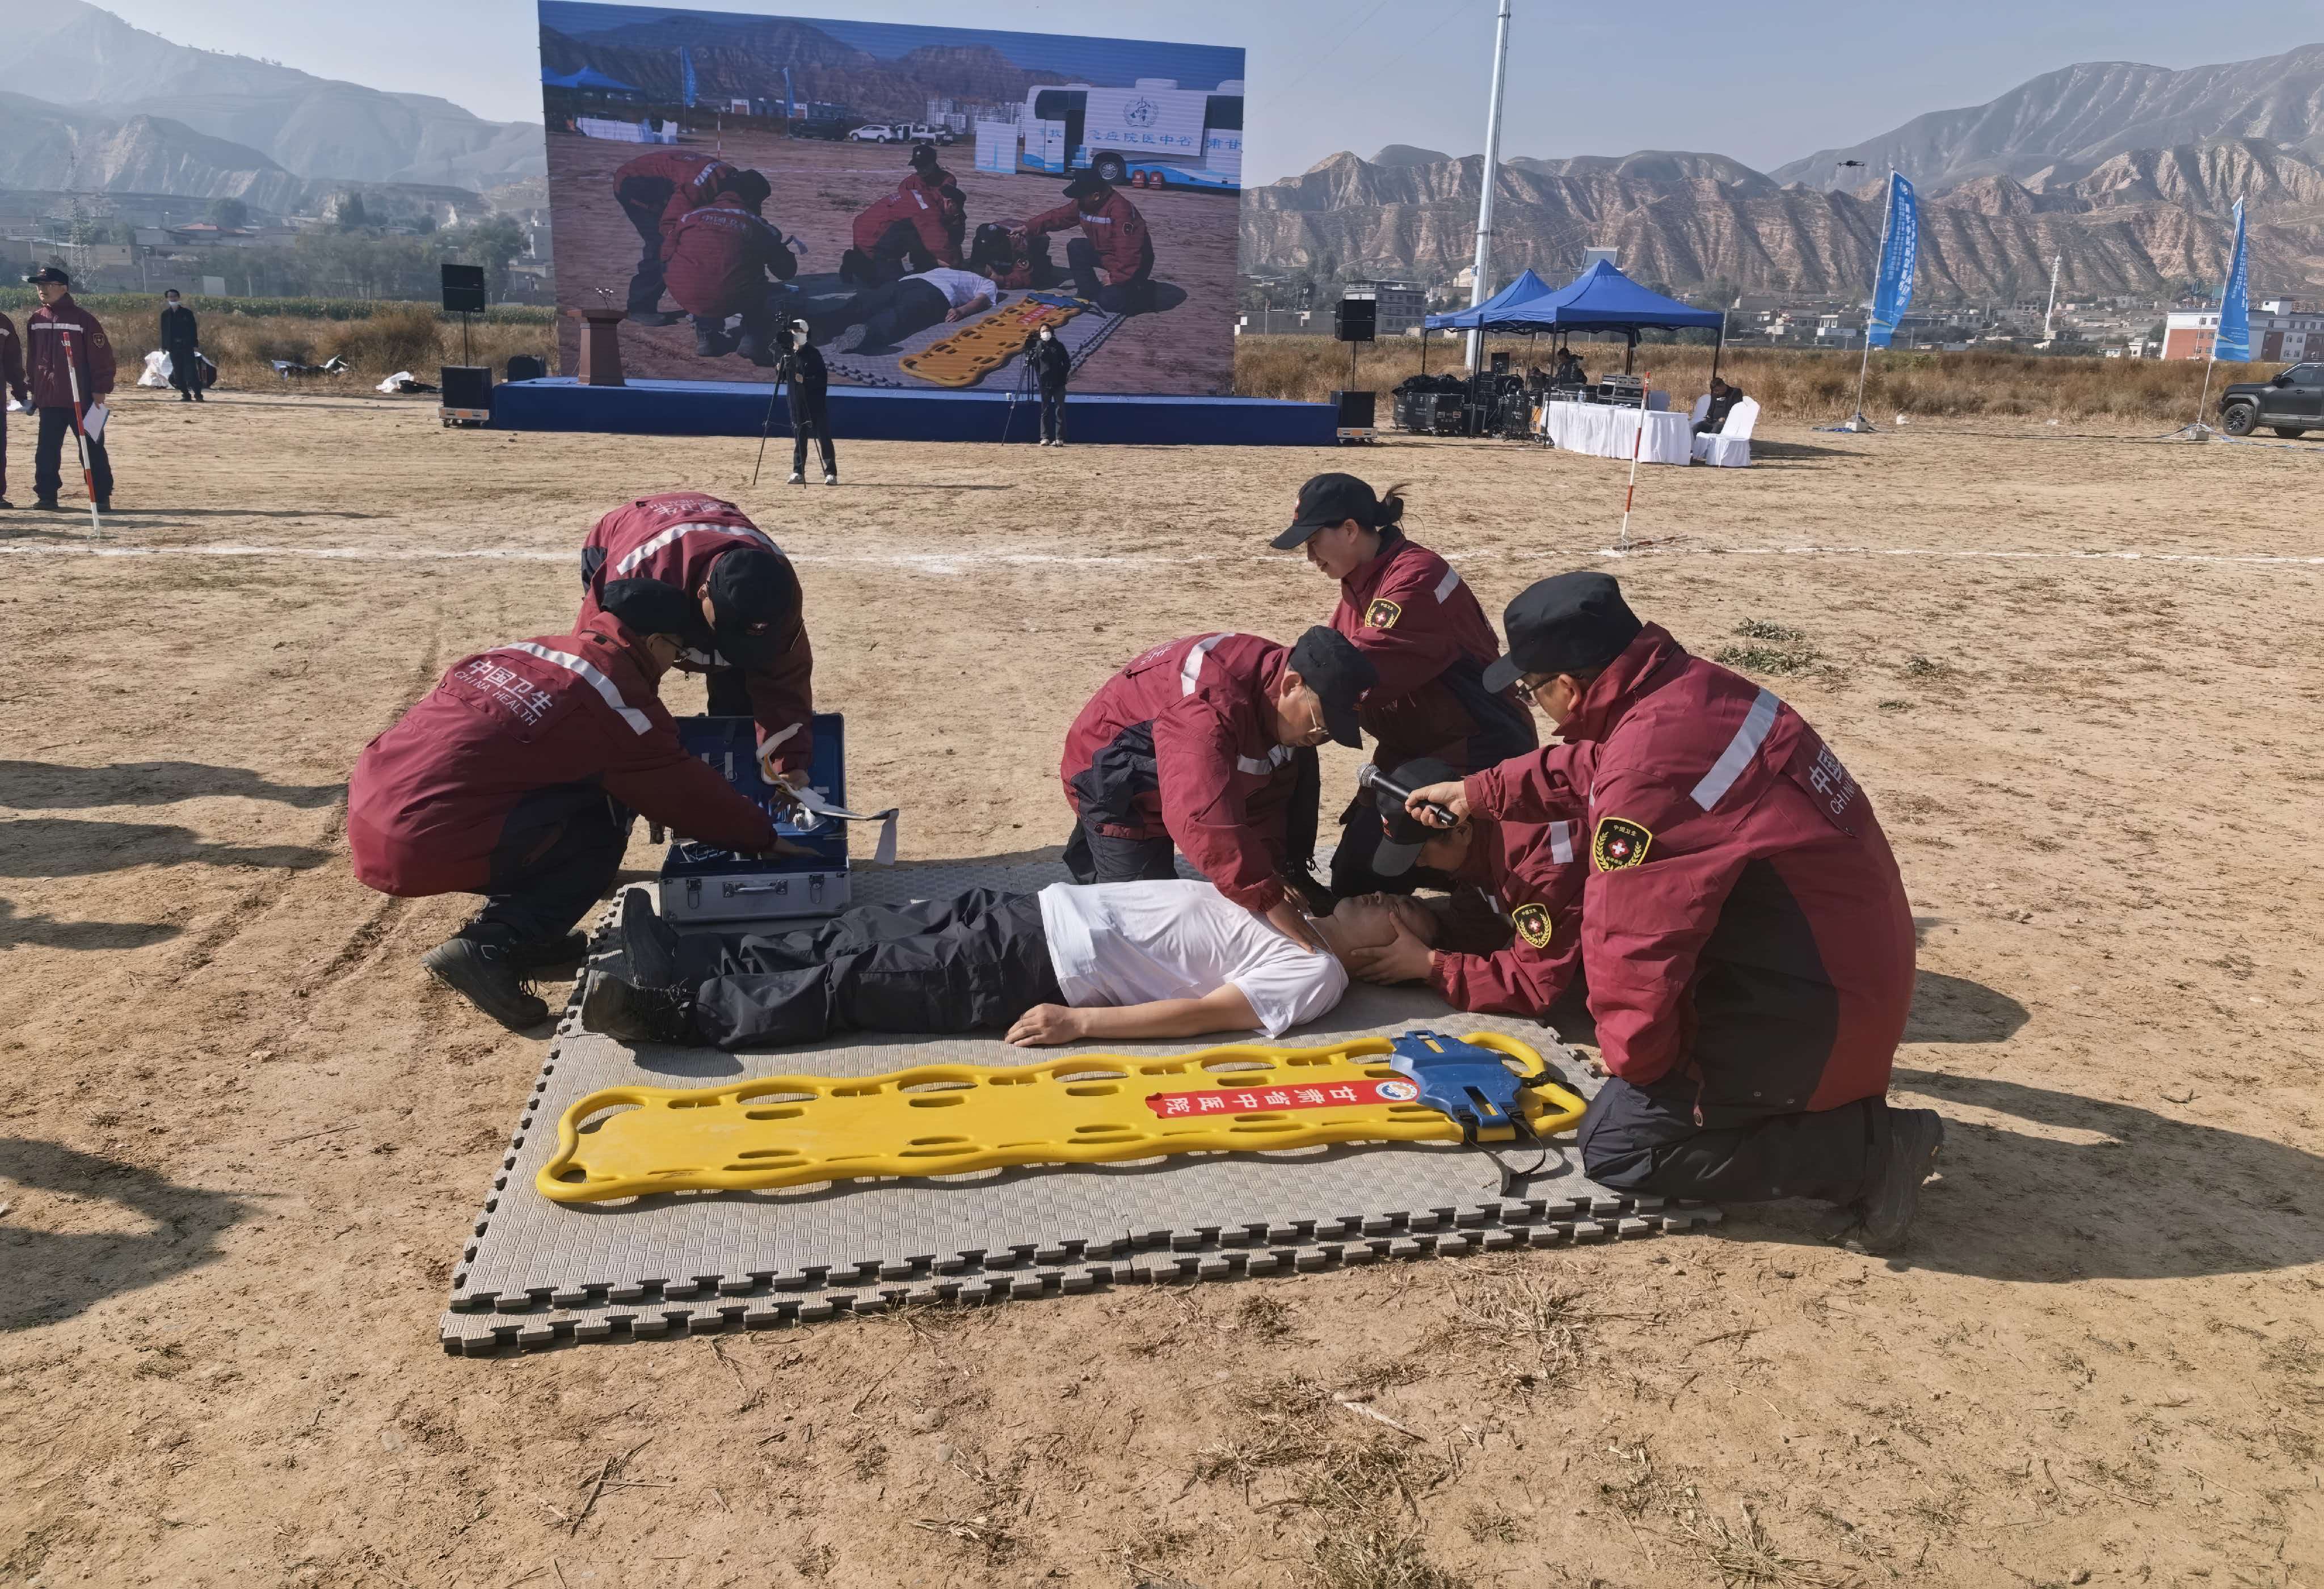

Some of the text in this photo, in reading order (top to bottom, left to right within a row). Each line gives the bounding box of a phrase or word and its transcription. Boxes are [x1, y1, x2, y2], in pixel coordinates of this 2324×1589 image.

[454, 671, 538, 726] CHINA HEALTH
[468, 660, 553, 718] 中国卫生
[1164, 1085, 1358, 1114] 甘肃省中医院
